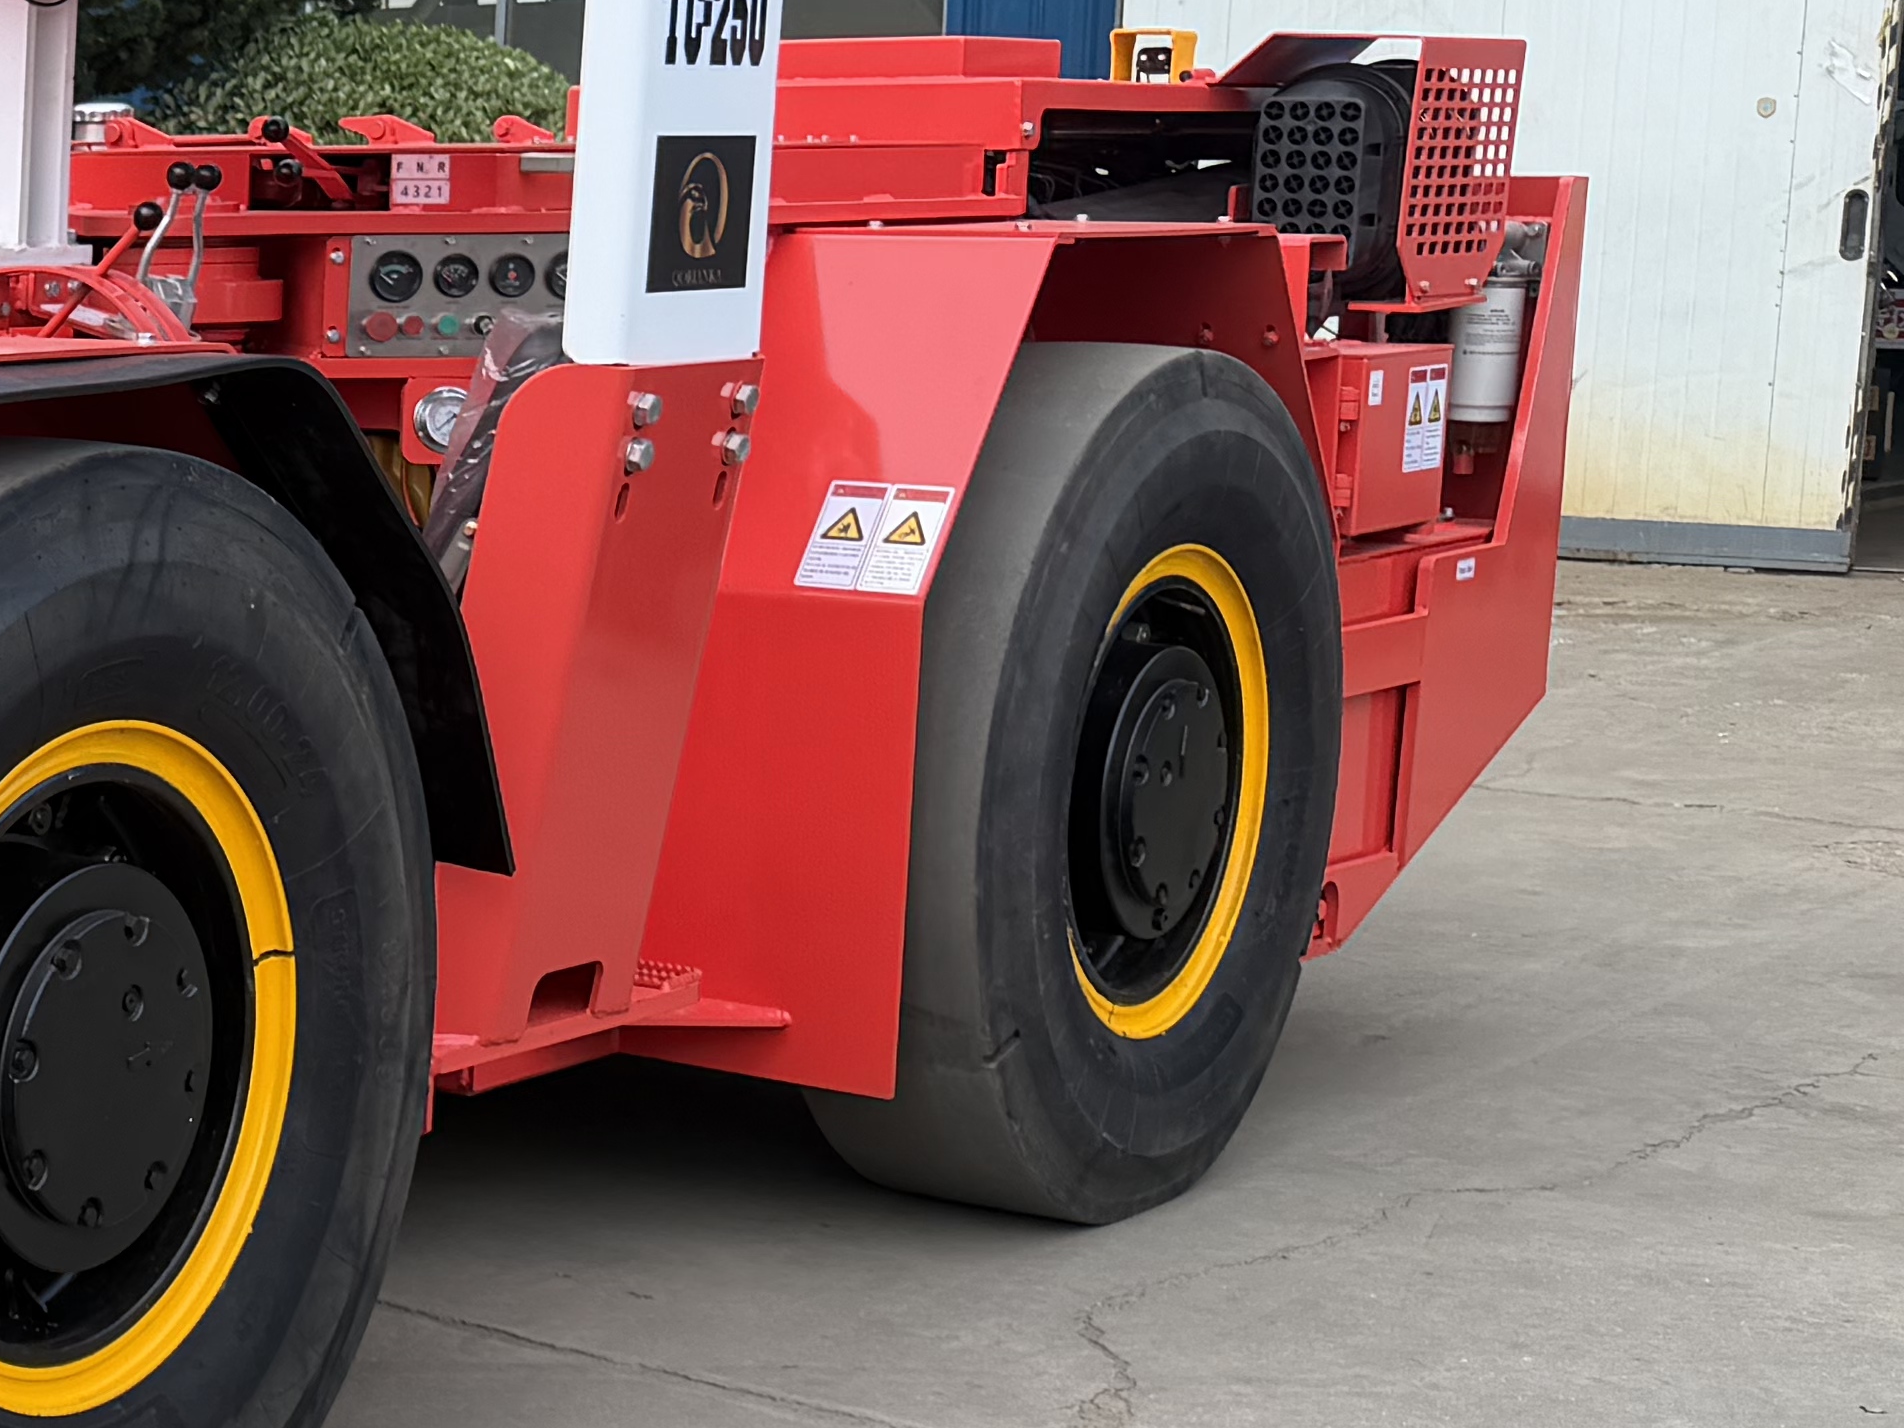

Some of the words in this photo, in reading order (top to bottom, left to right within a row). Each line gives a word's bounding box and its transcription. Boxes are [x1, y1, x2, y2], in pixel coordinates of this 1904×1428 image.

[396, 161, 404, 173] F
[416, 161, 424, 173] N
[437, 161, 446, 173] R
